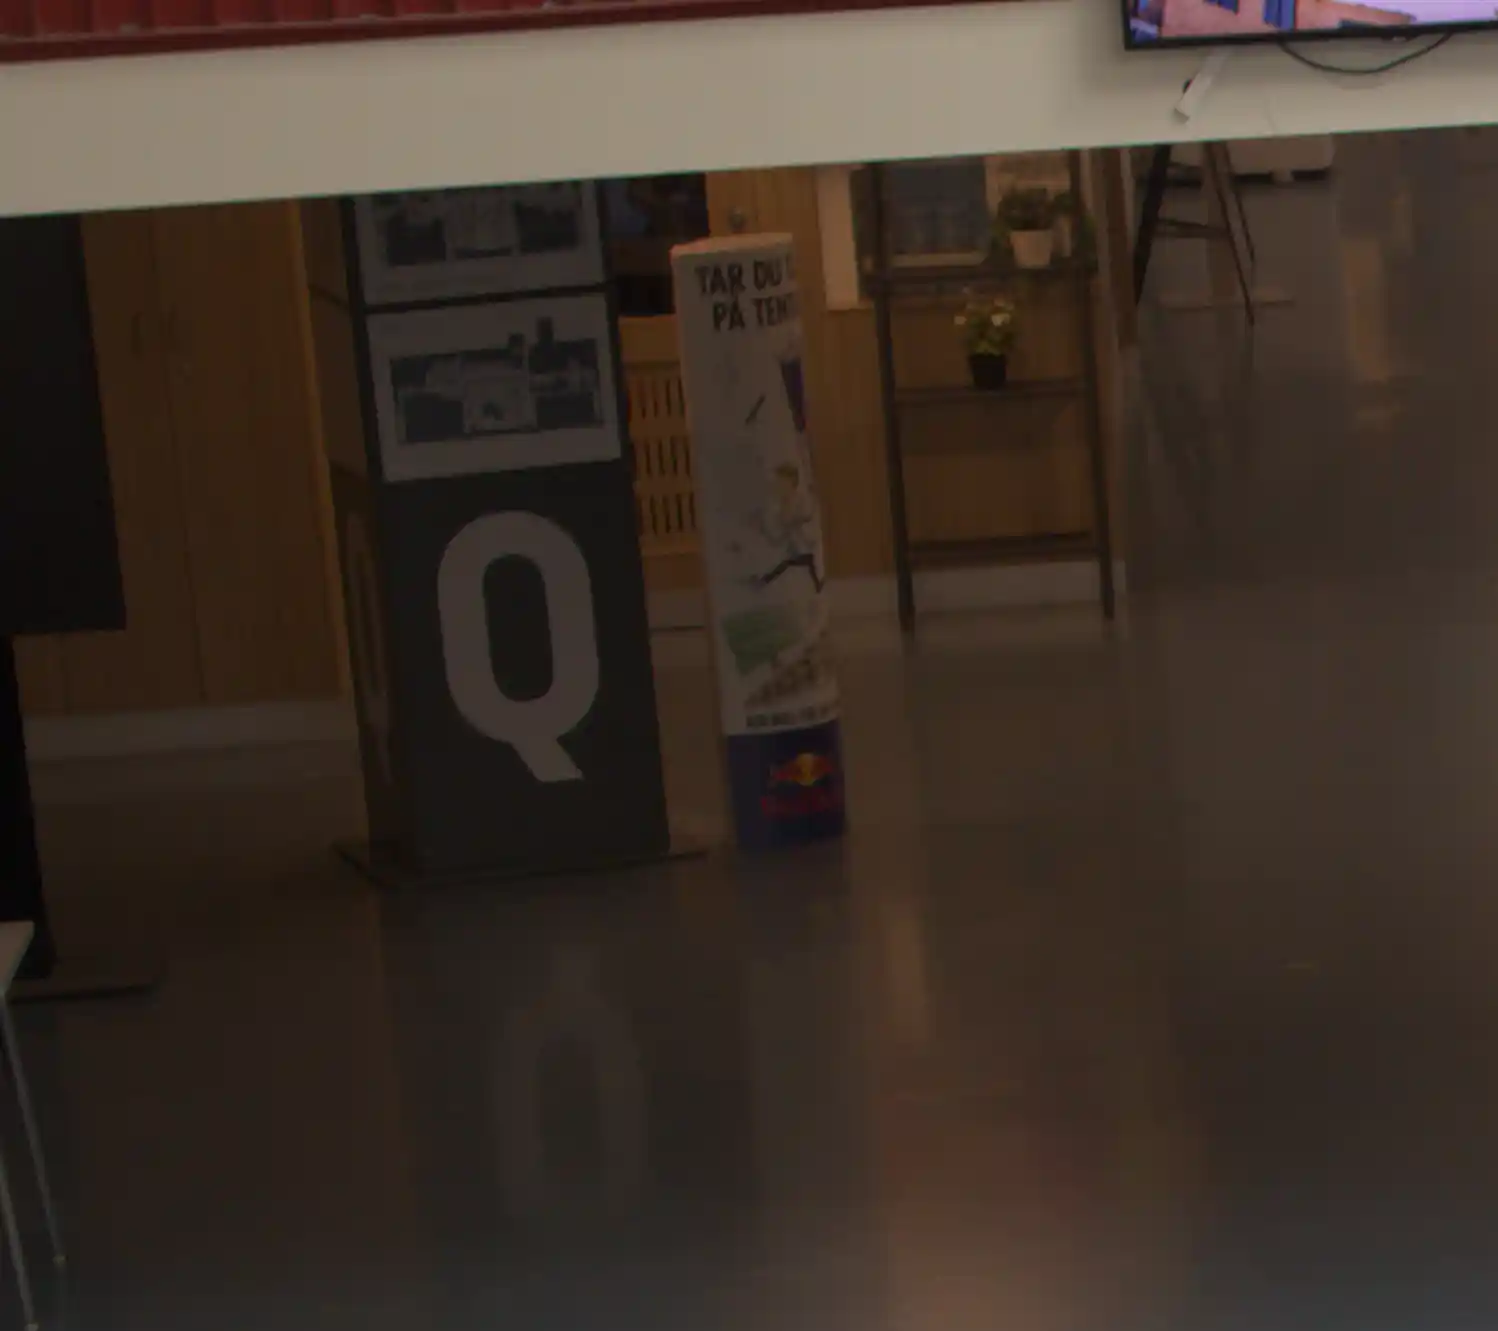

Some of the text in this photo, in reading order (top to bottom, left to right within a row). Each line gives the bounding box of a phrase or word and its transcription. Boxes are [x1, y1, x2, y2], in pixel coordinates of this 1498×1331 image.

[694, 258, 783, 296] TAR DU
[437, 509, 601, 783] Q
